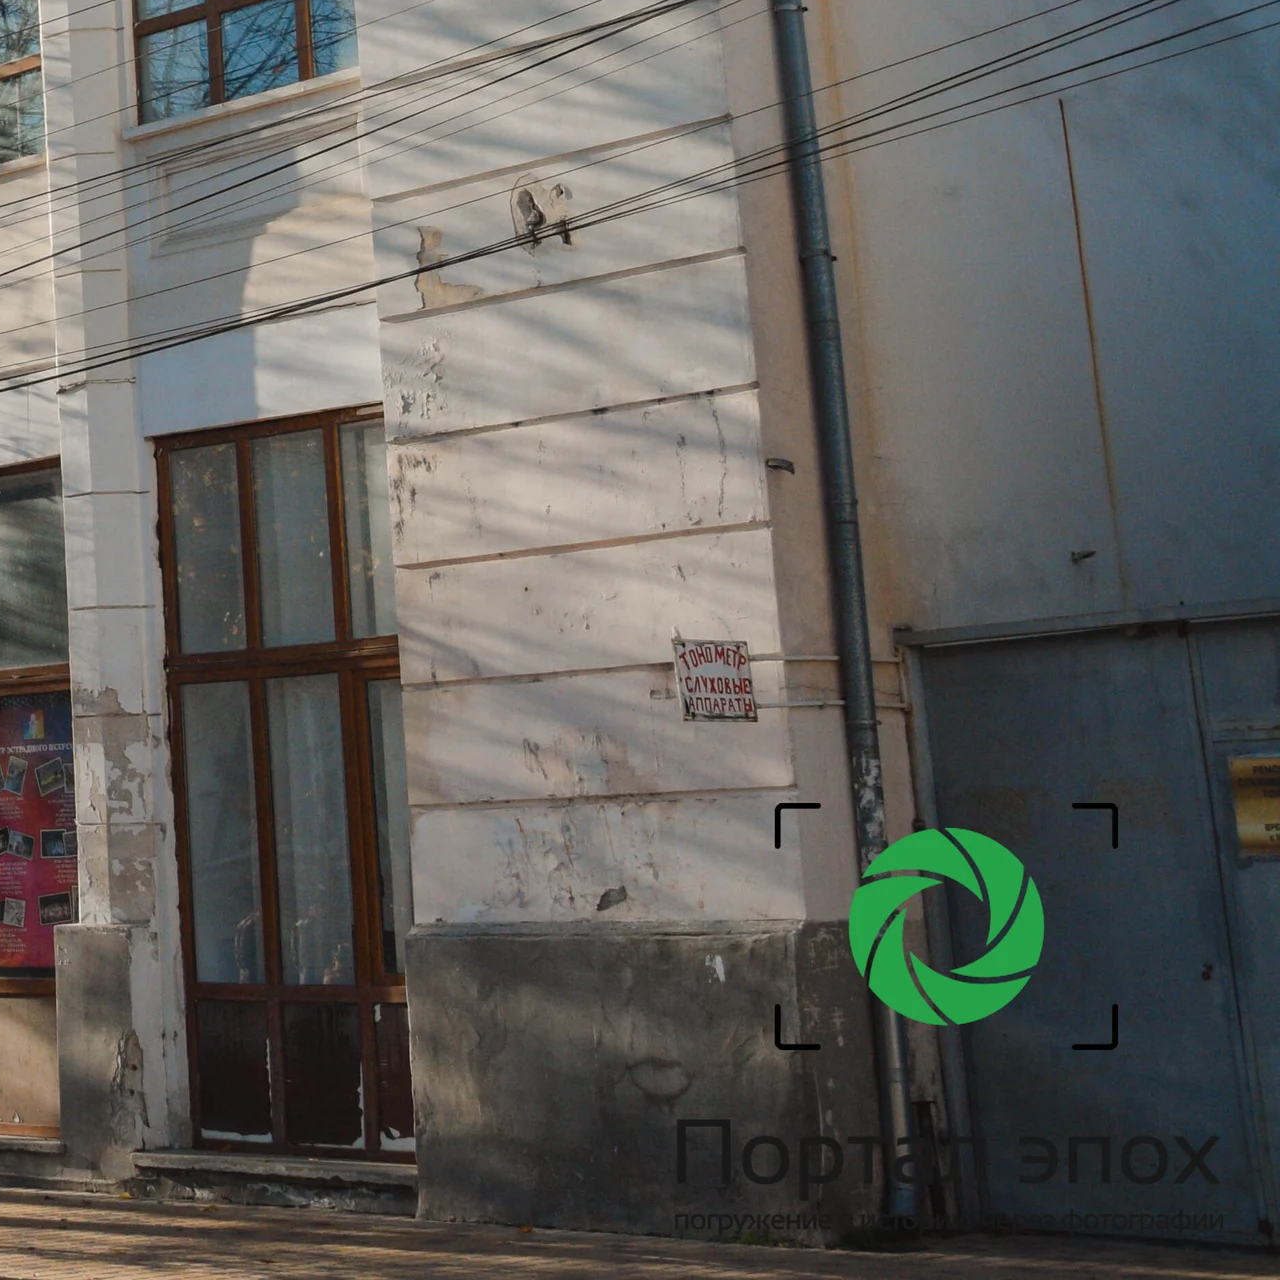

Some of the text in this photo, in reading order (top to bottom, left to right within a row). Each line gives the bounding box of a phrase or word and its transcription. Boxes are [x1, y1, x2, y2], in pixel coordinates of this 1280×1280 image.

[679, 646, 746, 671] ТОНОМЕТР
[684, 675, 752, 694] СЛУХОВЫЕ
[688, 697, 753, 712] АППАРАТЫ
